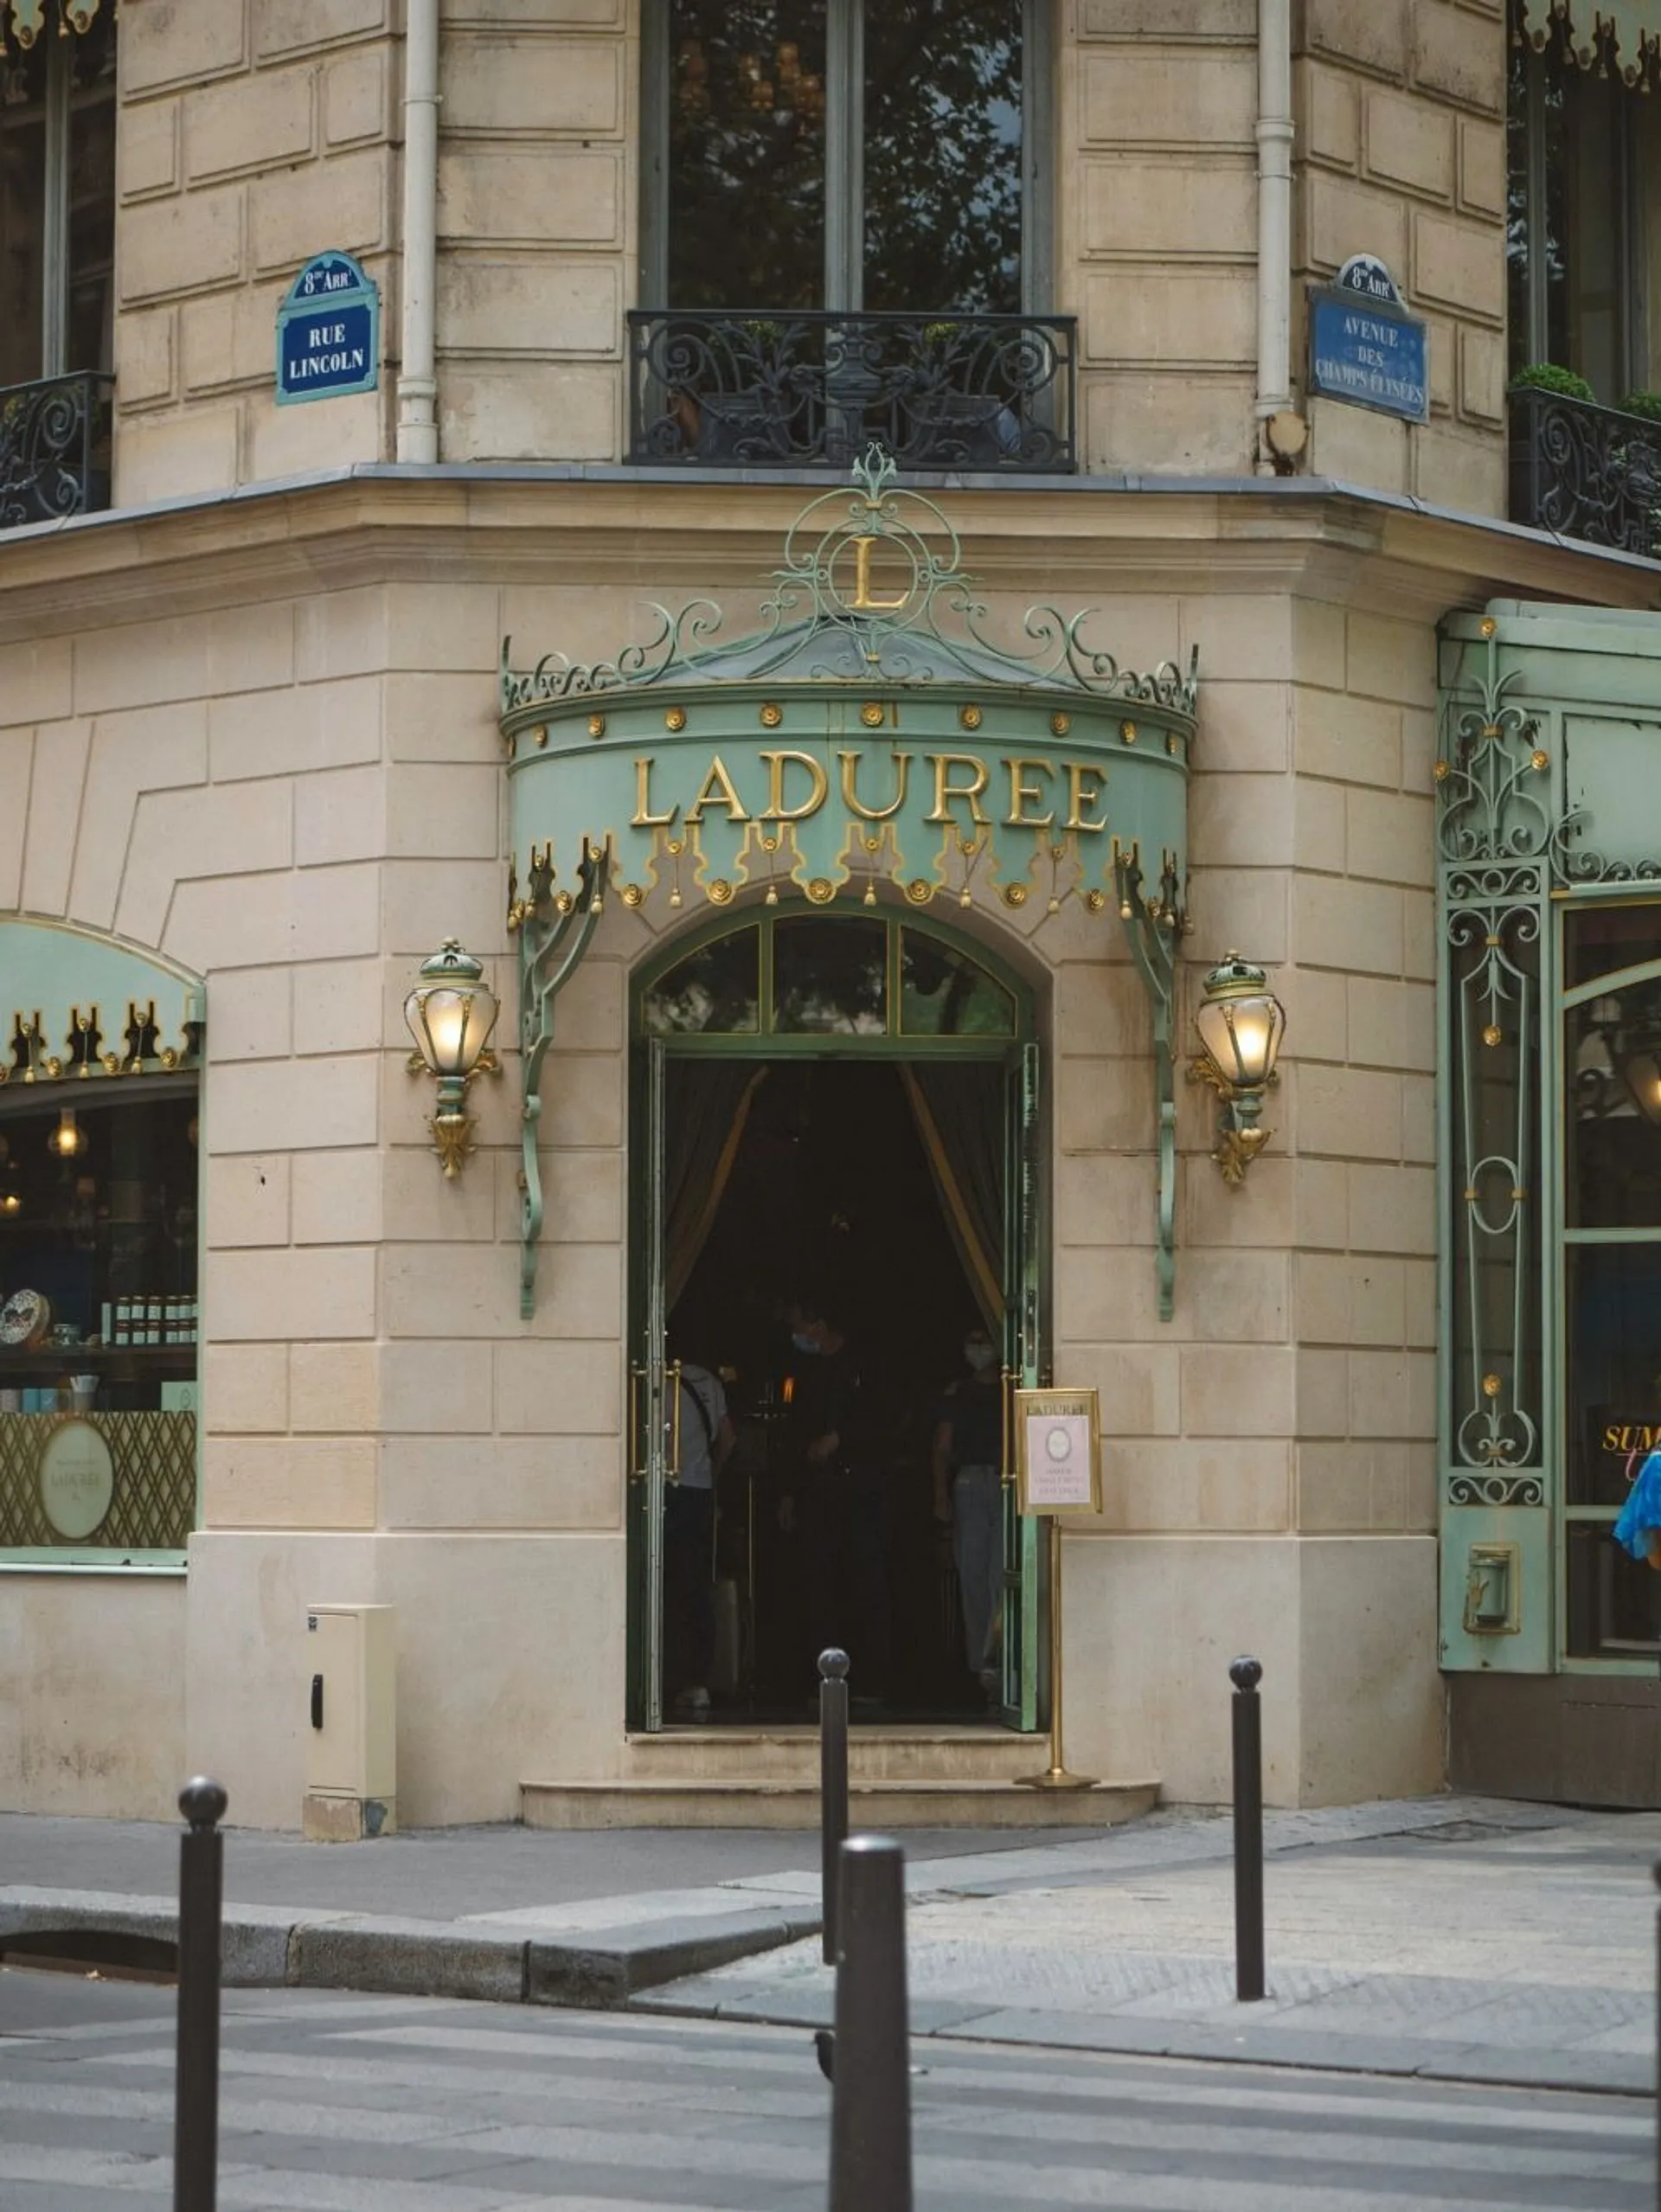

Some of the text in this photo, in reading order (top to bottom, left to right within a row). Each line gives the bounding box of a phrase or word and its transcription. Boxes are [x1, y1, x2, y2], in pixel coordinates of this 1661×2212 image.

[309, 324, 346, 348] RUE
[1344, 317, 1398, 347] AVENUE
[289, 349, 364, 380] LINCOLN
[1357, 345, 1384, 368] DES
[1315, 358, 1367, 388] CHAMPS
[850, 535, 909, 610] L
[629, 750, 1109, 833] LADUREE
